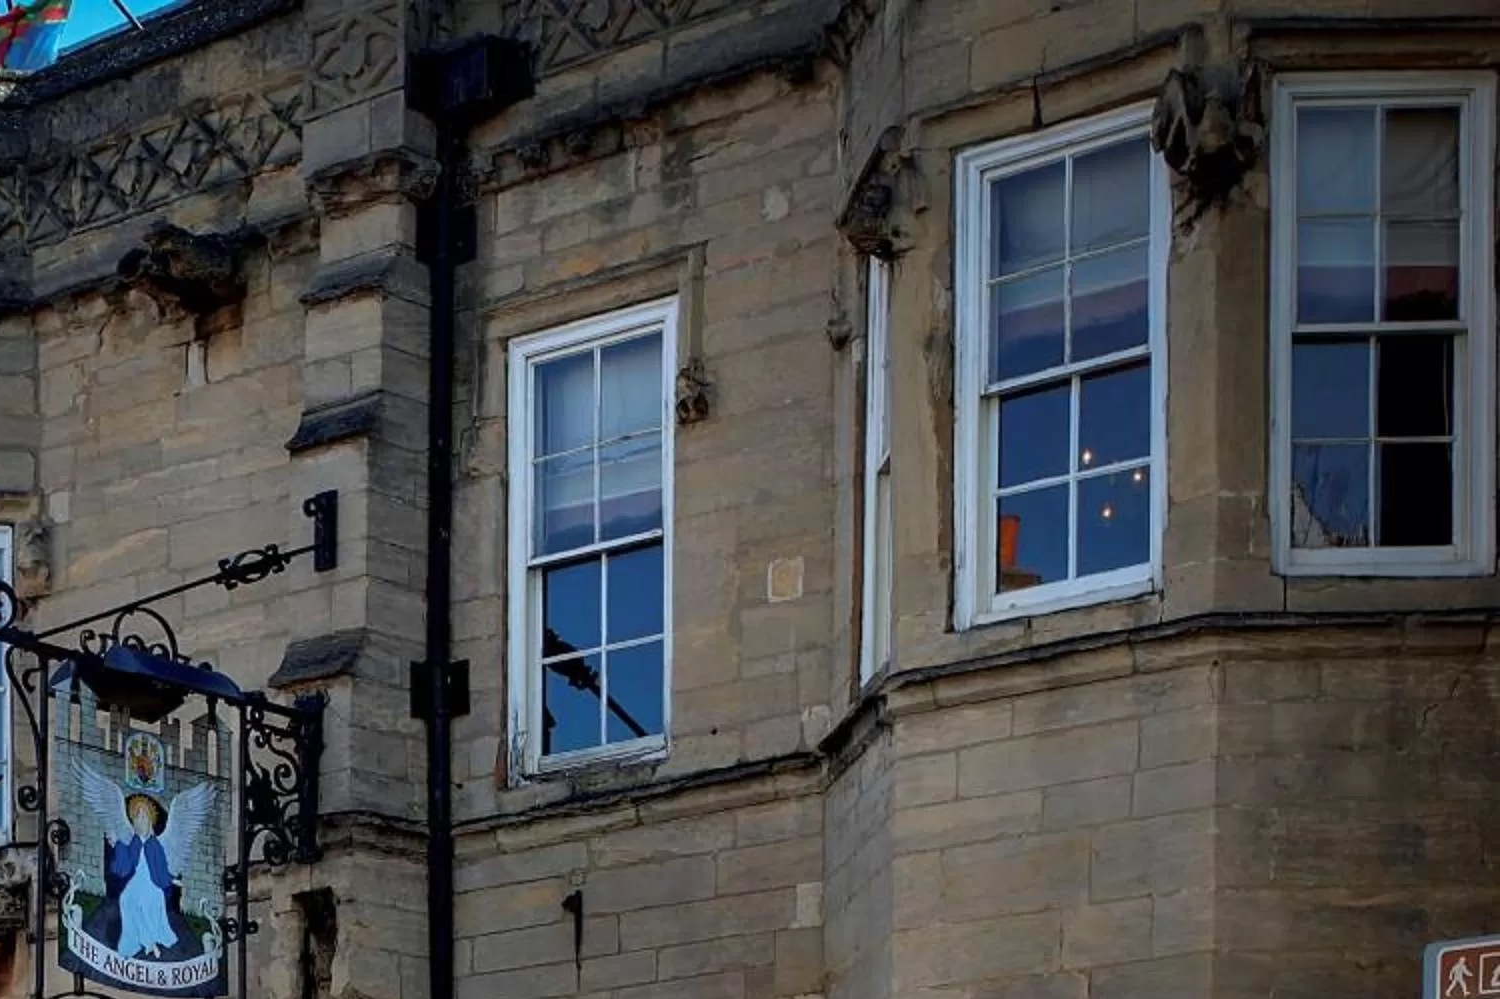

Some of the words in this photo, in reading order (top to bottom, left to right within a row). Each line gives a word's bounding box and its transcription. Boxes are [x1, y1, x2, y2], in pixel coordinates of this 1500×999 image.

[72, 928, 99, 965] THE
[103, 955, 153, 984] ANGEL
[157, 970, 167, 986] &
[172, 958, 217, 986] ROYAL
